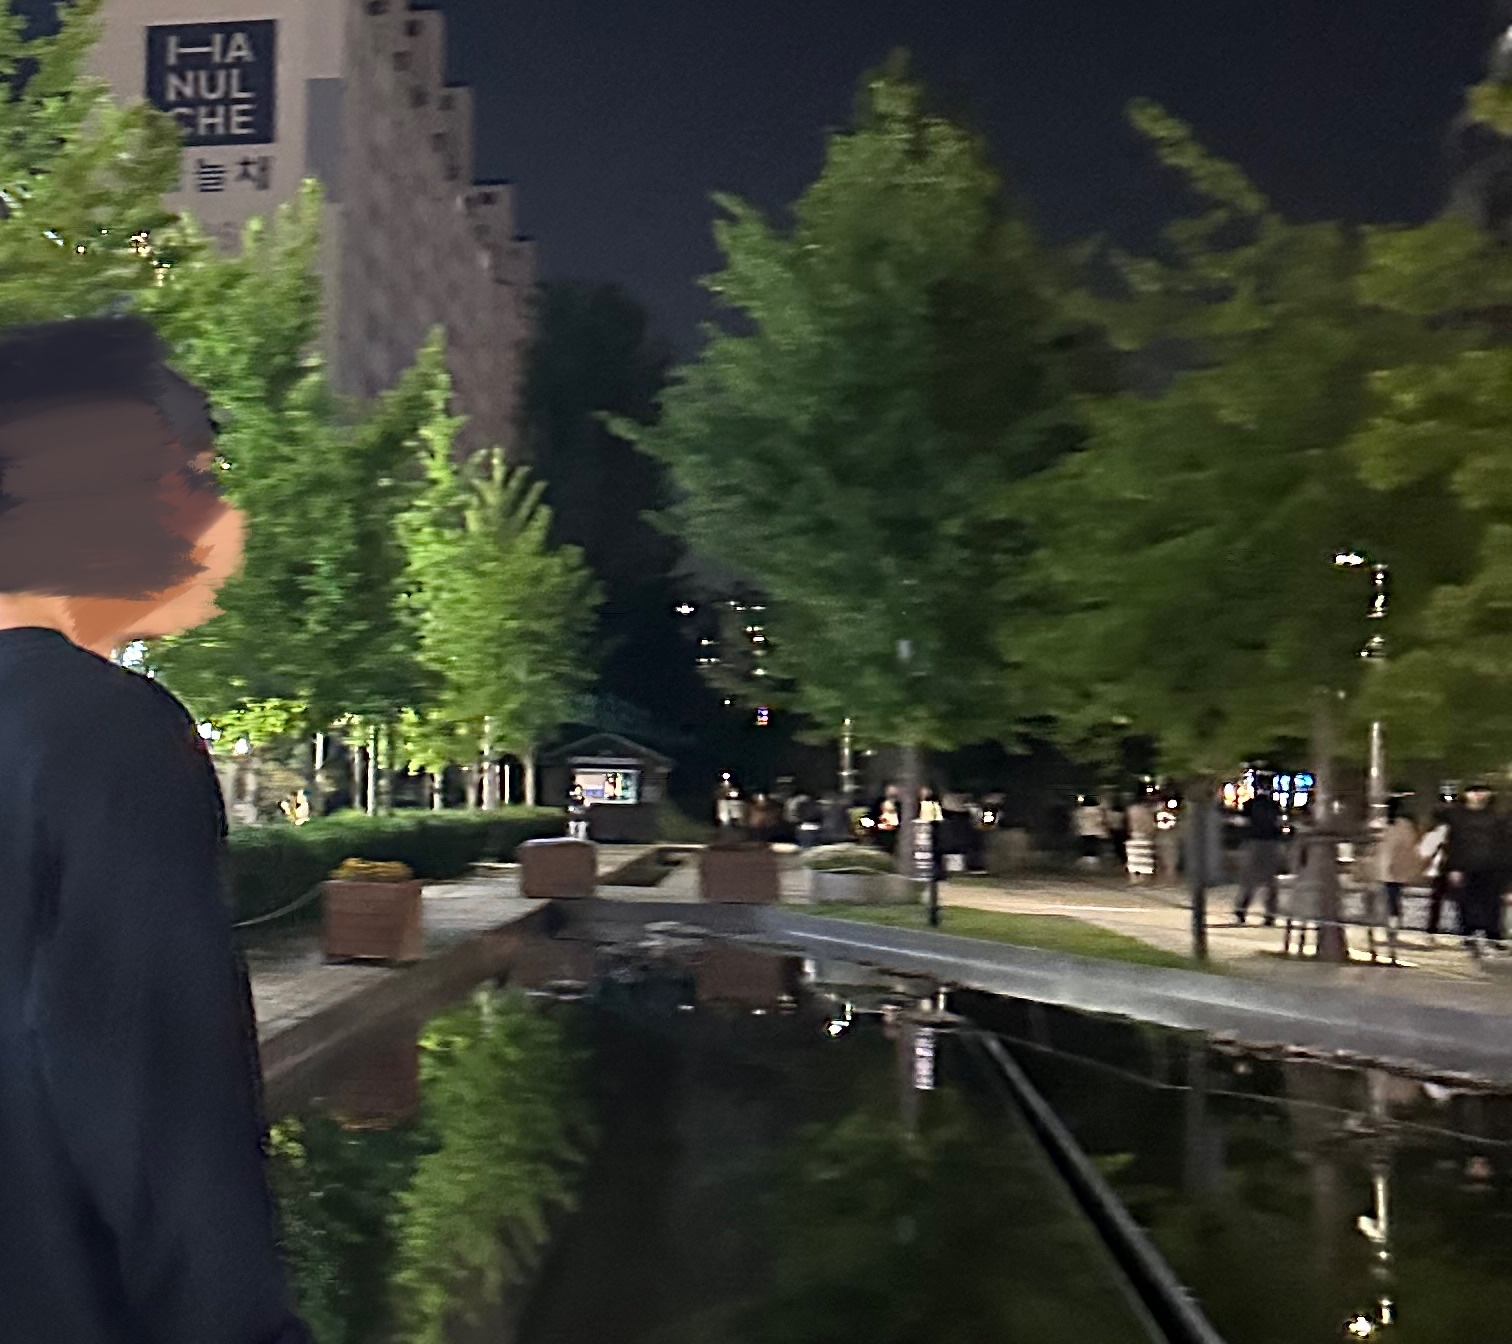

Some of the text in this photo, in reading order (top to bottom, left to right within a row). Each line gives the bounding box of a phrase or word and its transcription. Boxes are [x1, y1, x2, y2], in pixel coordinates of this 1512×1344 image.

[167, 32, 255, 65] HA
[166, 69, 256, 101] NUL
[192, 157, 271, 193] 늘채
